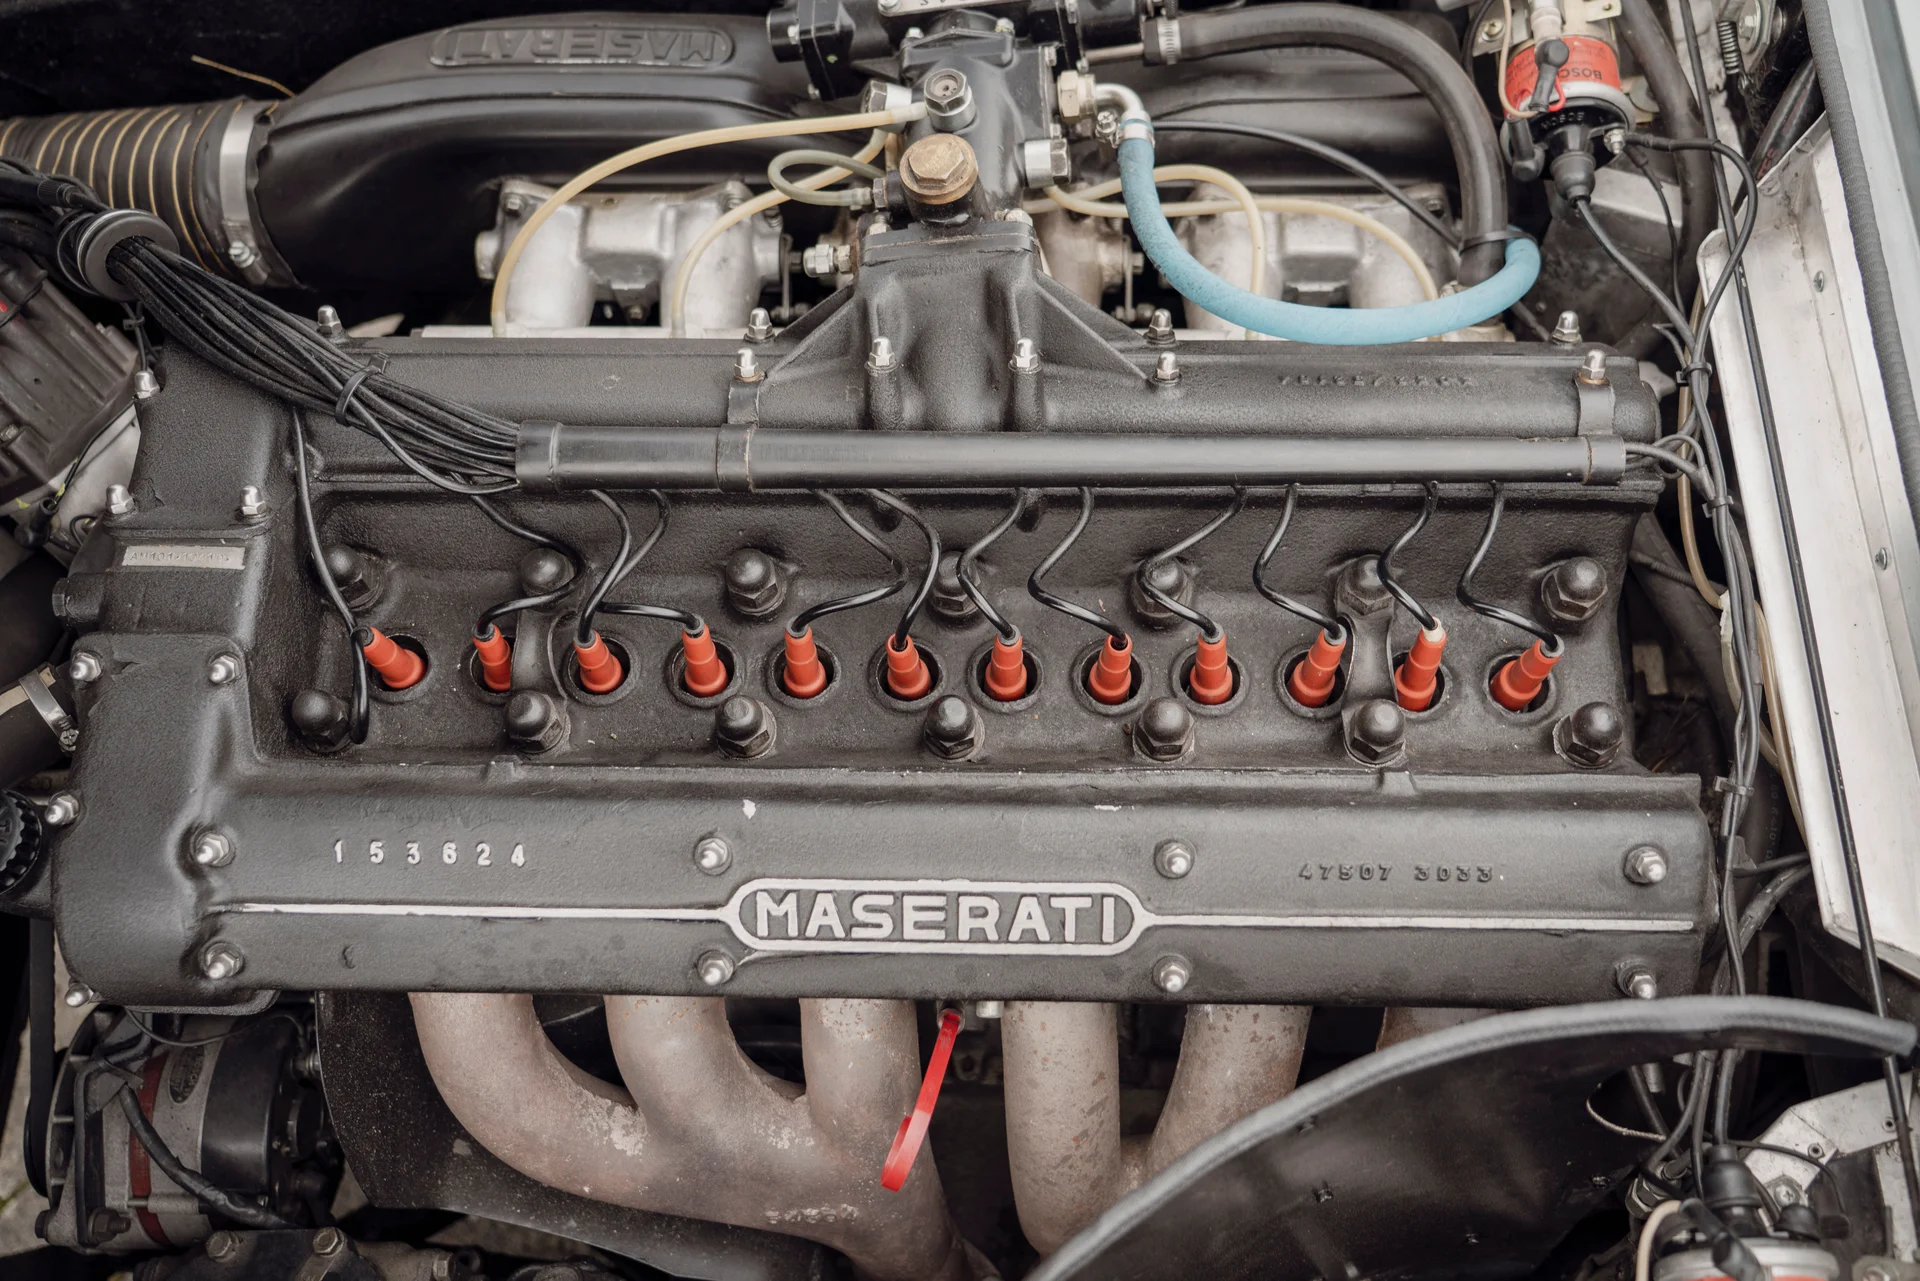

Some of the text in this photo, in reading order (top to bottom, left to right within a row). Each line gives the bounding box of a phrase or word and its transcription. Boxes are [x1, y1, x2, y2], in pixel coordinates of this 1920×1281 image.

[446, 28, 714, 61] MASERATI
[1559, 67, 1603, 80] BOSC
[754, 889, 1118, 944] MASERATI
